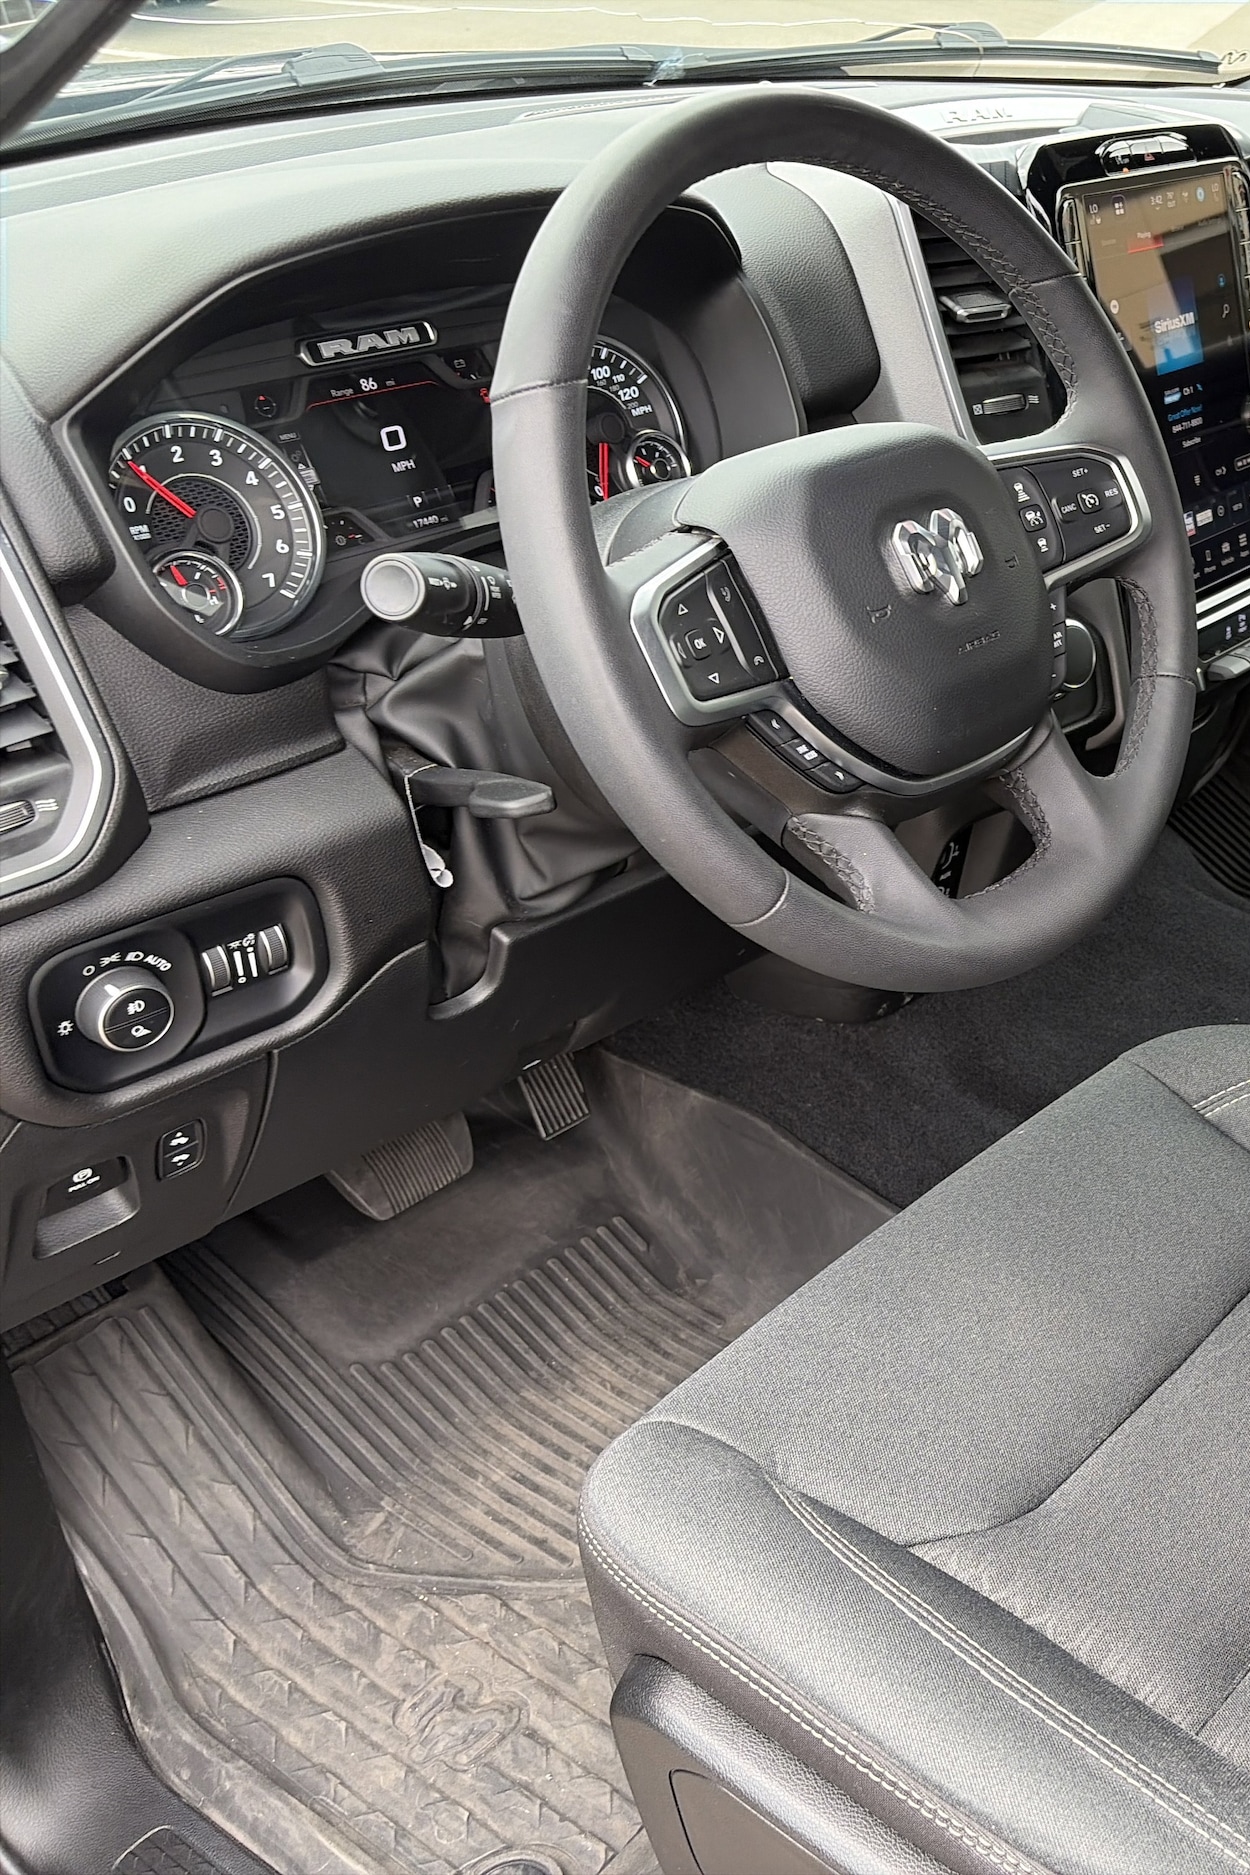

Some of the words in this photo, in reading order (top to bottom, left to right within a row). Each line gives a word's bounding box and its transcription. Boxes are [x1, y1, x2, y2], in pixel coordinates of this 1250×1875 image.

[1154, 312, 1195, 334] SiriusXM
[317, 326, 421, 360] RAM
[591, 365, 611, 381] 100
[612, 373, 625, 383] 110
[330, 386, 354, 398] Range
[359, 377, 378, 392] 86
[618, 386, 640, 401] 120
[631, 404, 653, 417] MPH
[380, 425, 407, 451] 0
[171, 445, 184, 463] 2
[209, 449, 223, 466] 3
[391, 459, 416, 473] MPH
[246, 471, 260, 486] 4
[1104, 487, 1119, 498] RES
[123, 496, 136, 513] 0
[412, 496, 423, 507] P
[1061, 503, 1077, 513] CANC
[270, 505, 285, 519] 5
[276, 539, 290, 553] 6
[262, 573, 276, 588] 7
[694, 637, 707, 651] OK
[143, 954, 172, 972] AUTO
